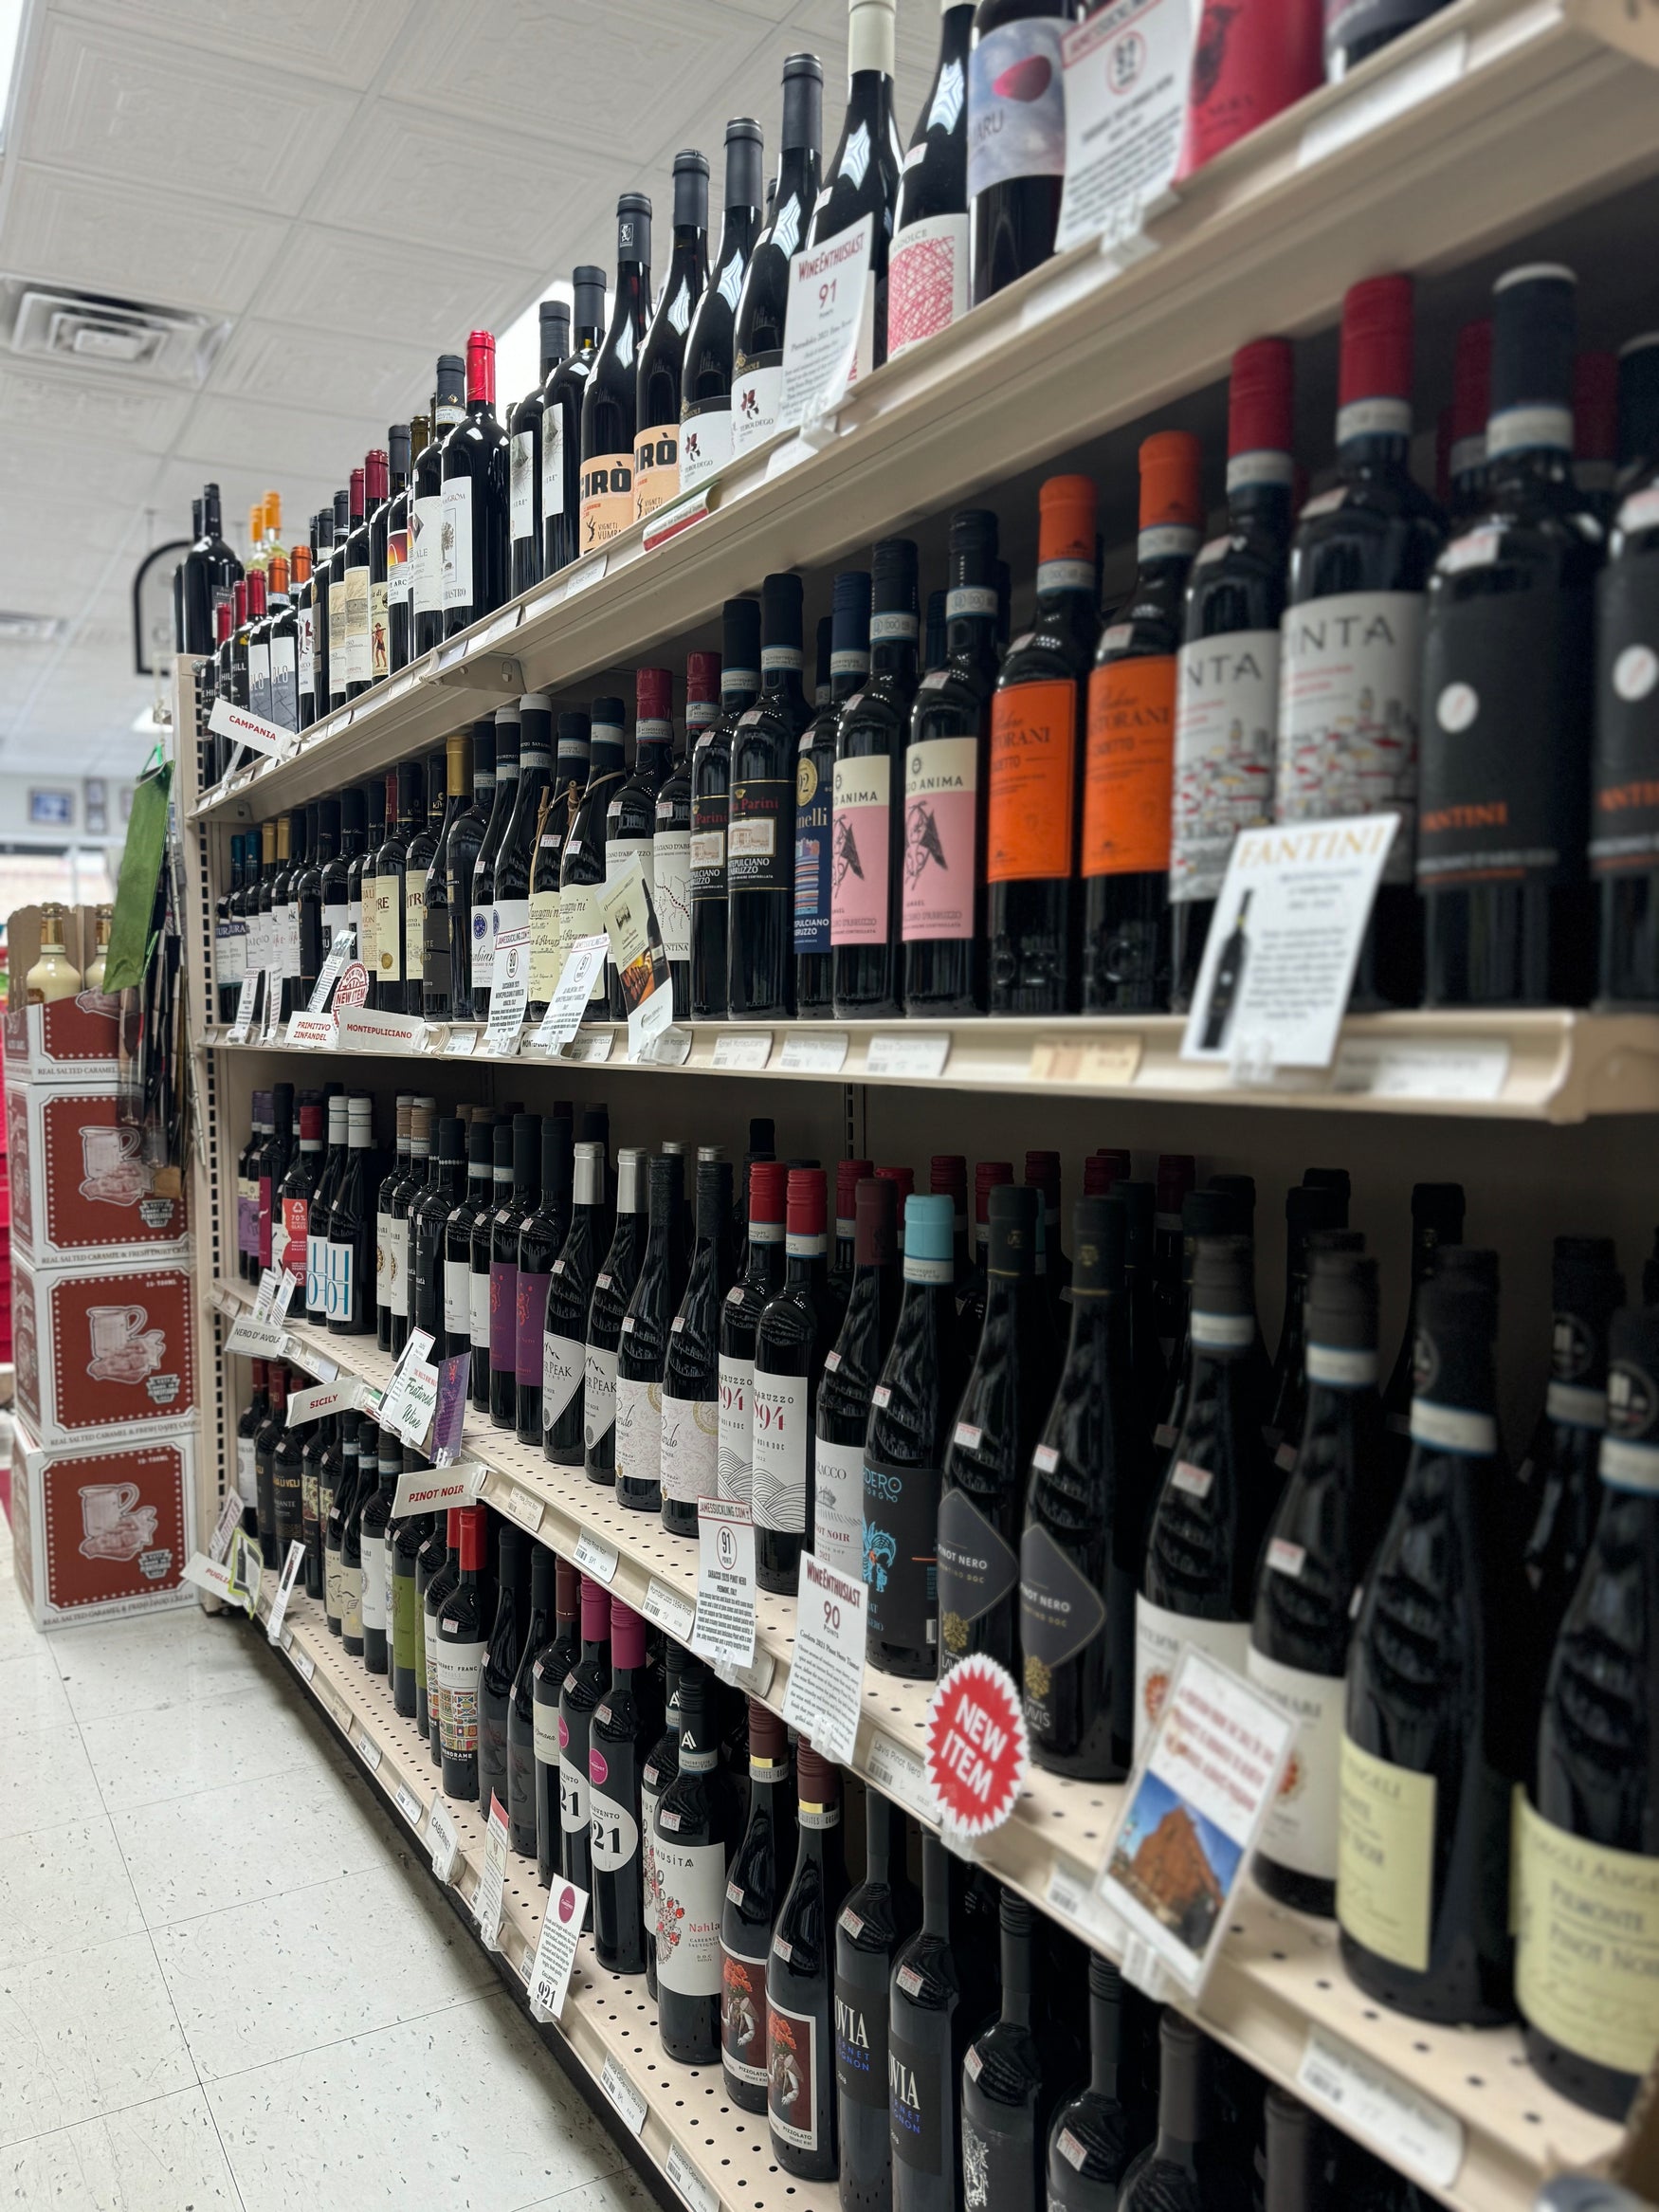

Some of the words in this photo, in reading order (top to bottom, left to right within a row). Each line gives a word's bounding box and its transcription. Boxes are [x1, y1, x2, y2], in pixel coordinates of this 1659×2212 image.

[818, 278, 837, 307] 91
[228, 715, 276, 740] CAMPANIA
[920, 775, 964, 791] ANIMA
[741, 796, 779, 810] Parini
[840, 791, 878, 806] ANIMA
[1239, 825, 1386, 868] FANTINI
[337, 992, 351, 1005] NEW
[352, 988, 366, 1002] ITEM
[297, 1021, 331, 1031] PRIMITIVO
[347, 1024, 412, 1039] MONTEPULICIANO
[294, 1031, 327, 1041] ZINFANDEL
[60, 1254, 87, 1263] SALTED
[87, 1252, 119, 1262] CARAMEL
[236, 1327, 252, 1338] NERO
[405, 1377, 436, 1407] Featured
[309, 1394, 338, 1409] SICILY
[402, 1404, 422, 1428] Wine
[69, 1435, 95, 1444] SALTED
[96, 1430, 127, 1441] CARAMEL
[409, 1488, 438, 1503] PINOT
[440, 1484, 465, 1498] NOIR
[700, 1502, 746, 1519] JAMESSUCKLING.COM
[721, 1531, 731, 1555] 91
[828, 1529, 850, 1543] NOIR
[958, 1554, 988, 1570] NERO
[1040, 1596, 1071, 1613] NERO
[61, 1614, 88, 1623] SALTED
[824, 1600, 840, 1630] 90
[955, 1693, 1009, 1762] NEW
[890, 1750, 905, 1769] Pinot
[906, 1762, 921, 1779] Nero
[940, 1728, 995, 1802] ITEM
[431, 1817, 451, 1853] CABERNET
[591, 1820, 622, 1855] 21
[689, 1922, 720, 1932] Nahla
[738, 2066, 768, 2077] PIZZOLATO
[782, 2126, 812, 2141] PIZZOLATO
